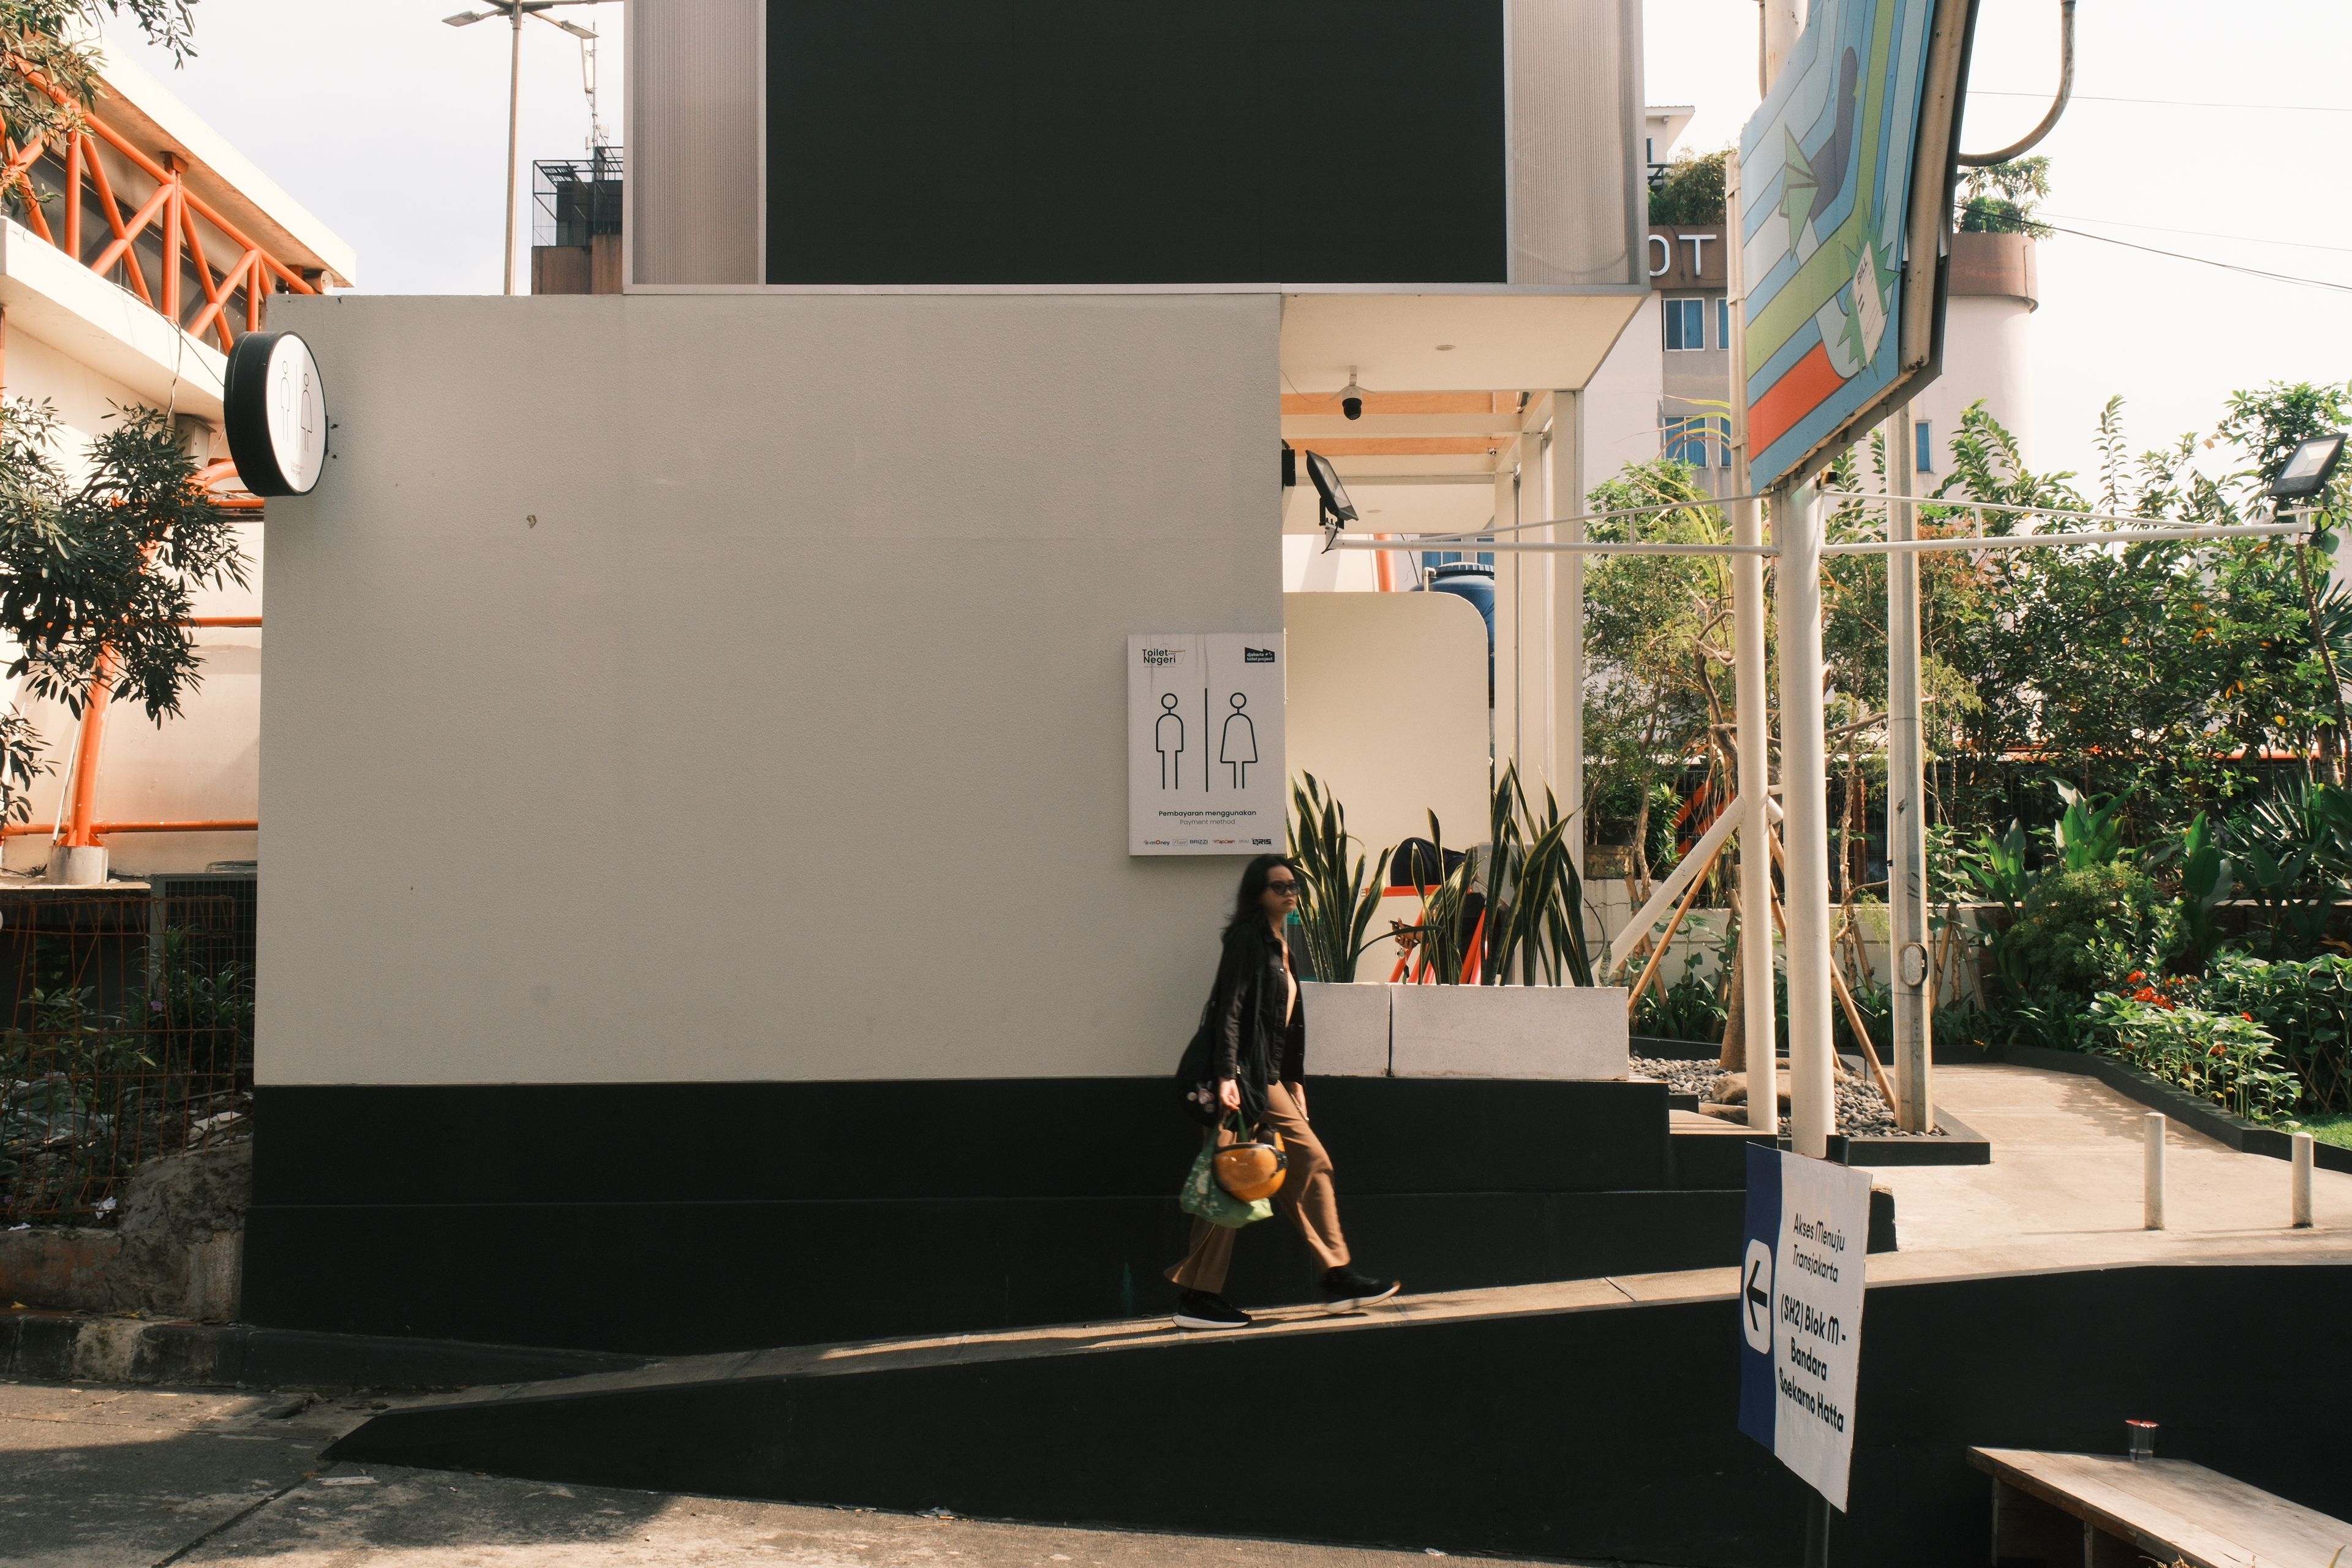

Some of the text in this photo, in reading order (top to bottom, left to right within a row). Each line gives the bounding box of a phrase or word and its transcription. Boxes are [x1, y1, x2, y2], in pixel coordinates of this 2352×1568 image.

[1857, 257, 1868, 285] BILL
[1144, 655, 1175, 666] Negeri
[1793, 1213, 1845, 1253] Akses Menuju
[1793, 1244, 1838, 1283] Transjakarta
[1781, 1294, 1803, 1333] (SH2)
[1805, 1305, 1825, 1339] Blok
[1828, 1316, 1839, 1345] M
[1791, 1336, 1827, 1381] Bandara
[1779, 1366, 1844, 1433] Soekarno Hatta
